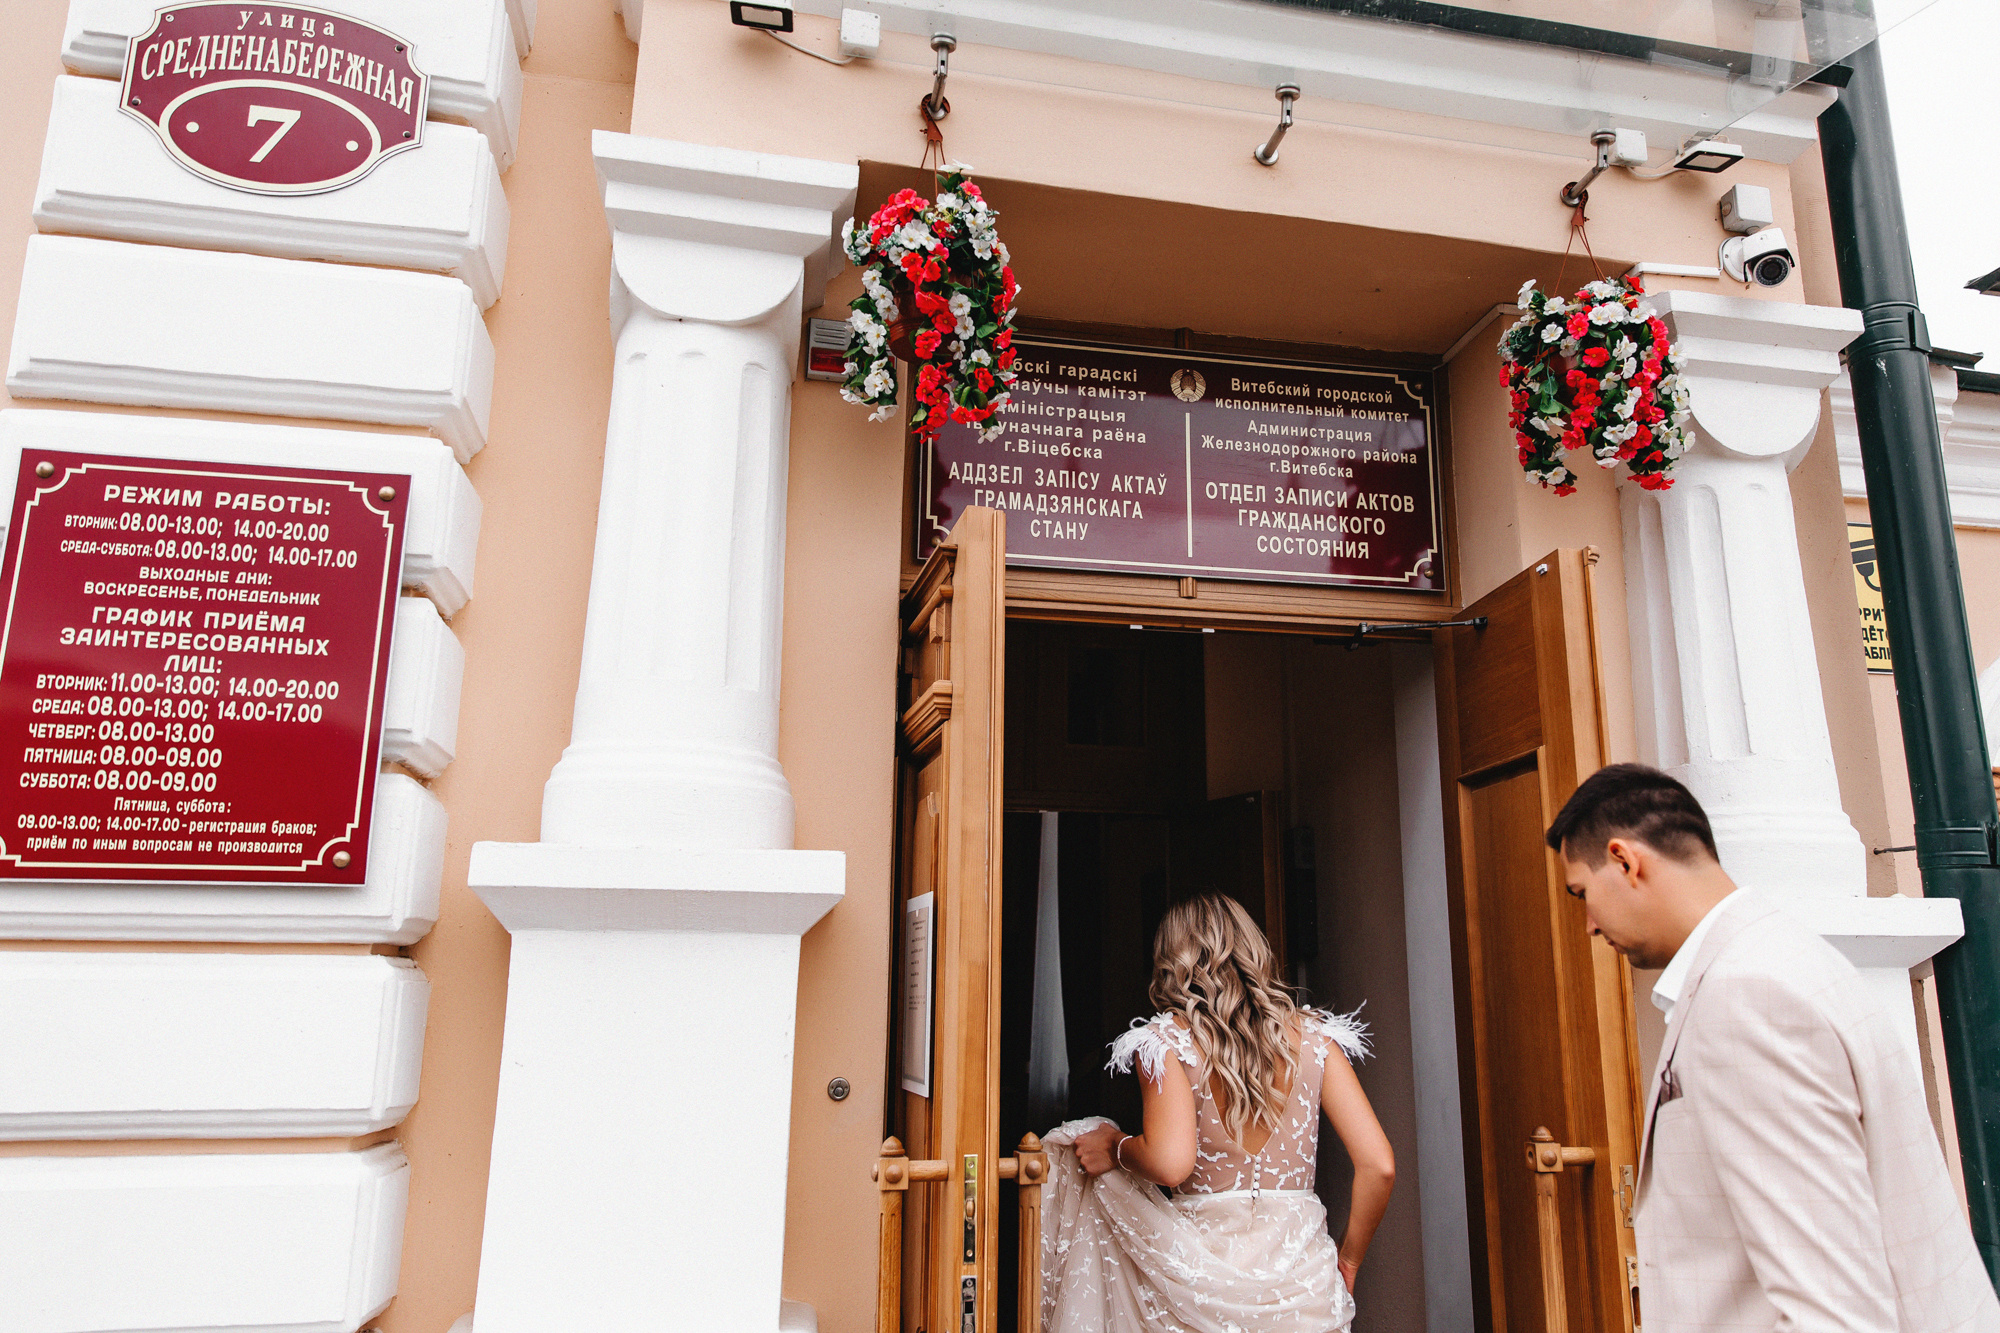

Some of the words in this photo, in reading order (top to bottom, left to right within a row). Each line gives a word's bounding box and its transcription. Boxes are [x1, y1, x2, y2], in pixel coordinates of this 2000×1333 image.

[238, 11, 334, 37] улица
[142, 34, 415, 116] СРЕДНЕНАБЕРЕЖНАЯ
[247, 105, 301, 162] 7
[1013, 358, 1049, 374] бскі
[1060, 366, 1136, 382] гарадскі
[1009, 378, 1068, 395] наўчы
[1078, 386, 1146, 401] камітэт
[1232, 378, 1309, 396] Витебский
[1318, 389, 1392, 403] городской
[1002, 401, 1126, 422] міністрацыя
[1216, 398, 1343, 418] исполнительный
[1352, 409, 1408, 422] комитет
[1093, 428, 1145, 443] раёна
[1248, 420, 1371, 442] Администрация
[1005, 439, 1102, 459] г.Віцебска
[1202, 435, 1355, 459] Железнодорожного
[1363, 449, 1416, 463] района
[949, 462, 1022, 485] АДДЗЕЛ
[1035, 468, 1099, 490] ЗАПІСУ
[1112, 473, 1166, 495] АКТАЎ
[1270, 460, 1352, 477] г.Витебска
[104, 485, 202, 507] РЕЖИМ
[215, 492, 330, 515] РАБОТЫ:
[973, 490, 1143, 520] ГРАМАДЗЯНСКАГА
[1206, 482, 1265, 504] ОТДЕЛ
[1275, 487, 1347, 507] ЗАПИСИ
[1356, 493, 1414, 512] АКТОВ
[65, 515, 117, 529] ВТОРНИК:
[120, 512, 222, 538] 08.00-13.00;
[235, 519, 329, 542] 14.00-20.00
[1031, 520, 1088, 540] СТАНУ
[1237, 509, 1385, 537] ГРАЖДАНСКОГО
[61, 540, 152, 557] СРЕДА-СУББОТА:
[155, 540, 257, 565] 08.00-13.00;
[269, 546, 357, 568] 14.00-17.00
[1257, 535, 1368, 558] СОСТОЯНИЯ
[140, 567, 229, 582] ВЫХОДНЫЕ
[235, 572, 272, 585] ДНИ:
[84, 582, 202, 601] ВОСКРЕСЕНЬЕ,
[206, 588, 320, 605] ПОНЕДЕЛЬНИК
[92, 607, 193, 627] ГРАФИК
[204, 611, 305, 632] ПРИЁМА
[60, 628, 329, 655] ЗАИНТЕРЕСОВАННЫХ
[164, 655, 222, 673] ЛИЦ:
[37, 675, 107, 691] ВТОРНИК:
[112, 673, 219, 698] 11.00-13.00;
[230, 677, 339, 699] 14.00-20.00
[33, 699, 84, 714] СРЕДА:
[88, 696, 208, 721] 08.00-13.00;
[218, 701, 322, 723] 14.00-17.00
[29, 723, 95, 739] ЧЕТВЕРГ:
[99, 721, 214, 743] 08.00-13.00
[24, 748, 97, 764] ПЯТНИЦА:
[100, 745, 222, 767] 08.00-09.00
[20, 773, 91, 789] СУББОТА:
[94, 770, 216, 792] 08.00-09.00
[114, 797, 170, 813] Пятница,
[177, 799, 231, 815] суббота:
[18, 815, 101, 831] 09.00-13.00;
[272, 820, 317, 836] браков;
[27, 835, 66, 851] приём
[73, 839, 87, 849] по
[93, 839, 127, 850] иным
[133, 840, 192, 853] вопросам
[198, 841, 212, 851] не
[218, 842, 302, 854] производится
